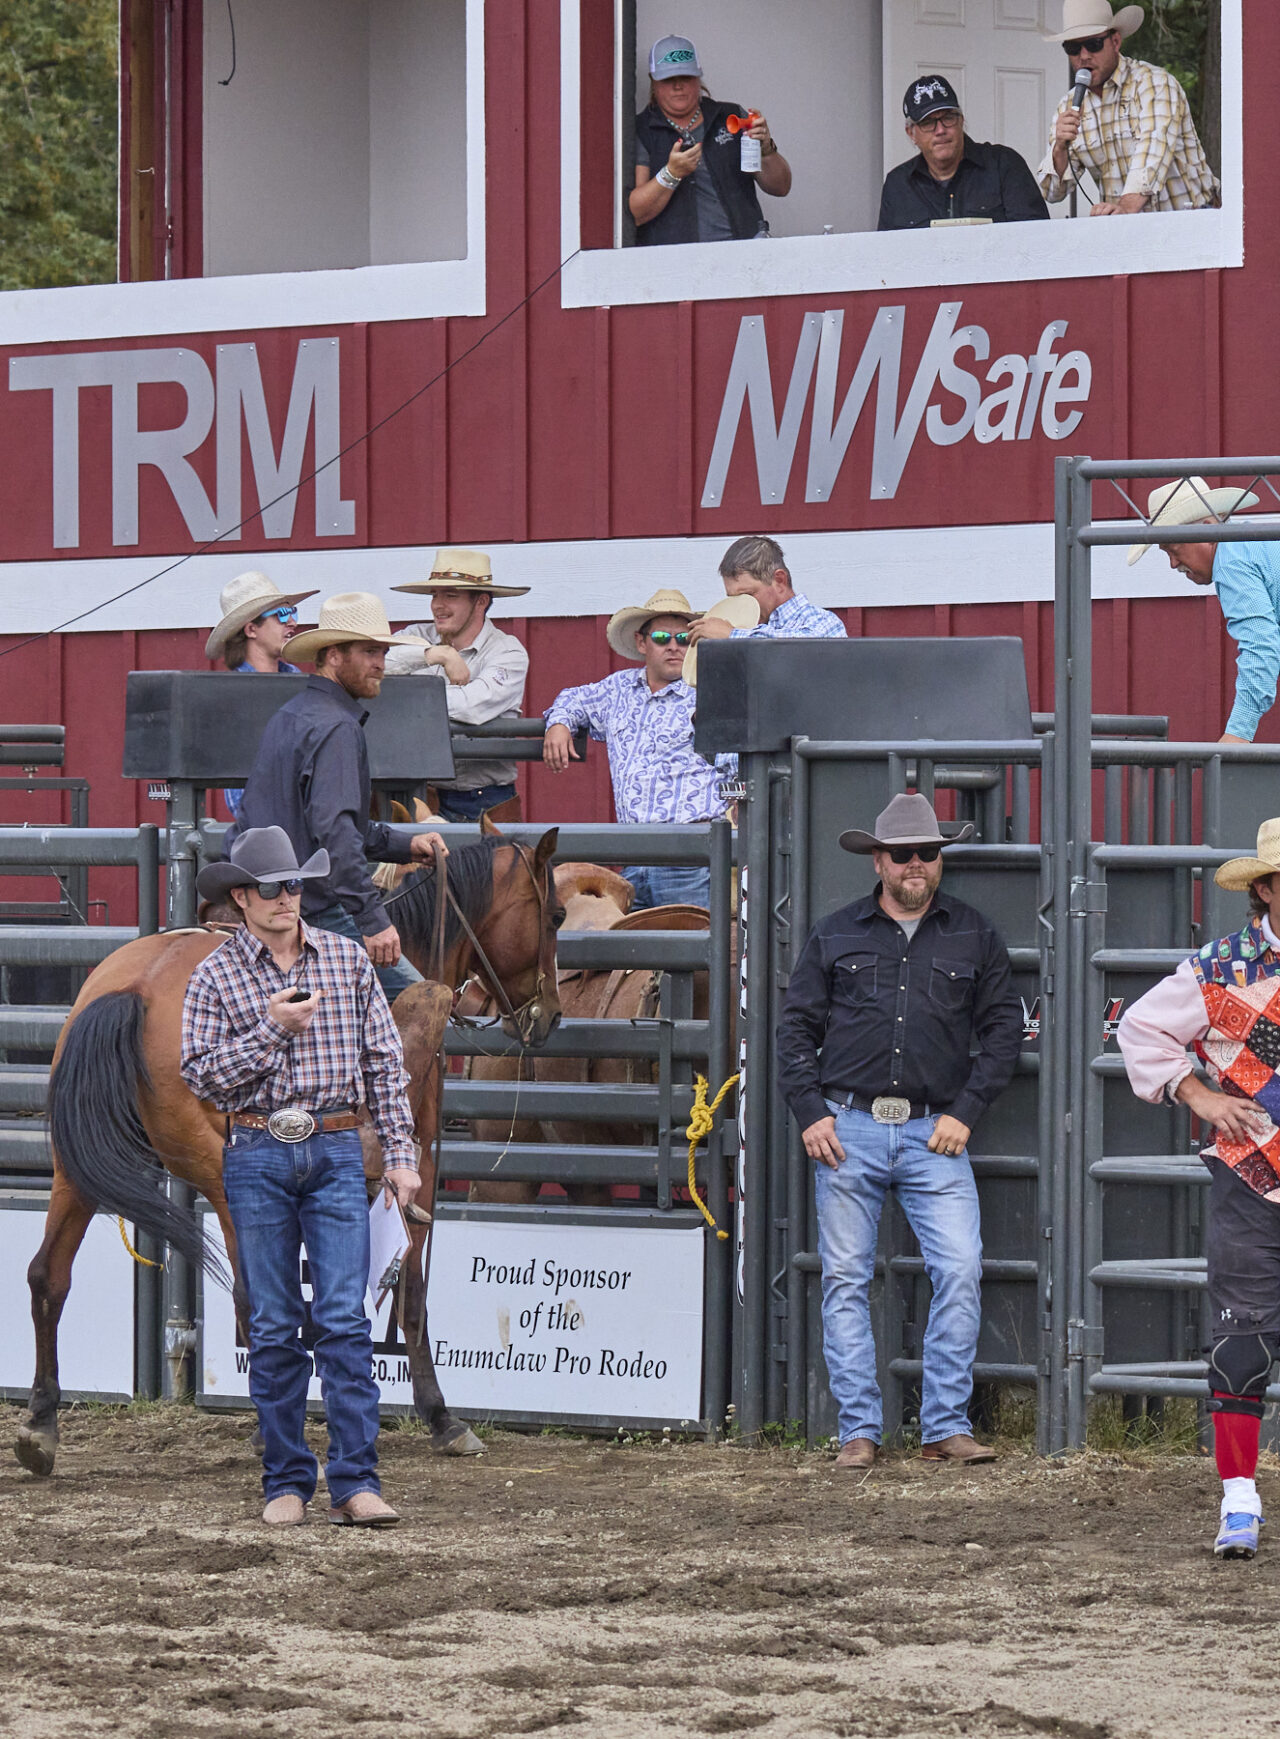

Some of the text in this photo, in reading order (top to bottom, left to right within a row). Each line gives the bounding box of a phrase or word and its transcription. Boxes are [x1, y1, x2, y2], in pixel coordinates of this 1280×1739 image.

[470, 1256, 632, 1296] Proud Sponsor
[519, 1301, 581, 1338] of the
[433, 1340, 668, 1380] Enumclaw Pro Rodeo
